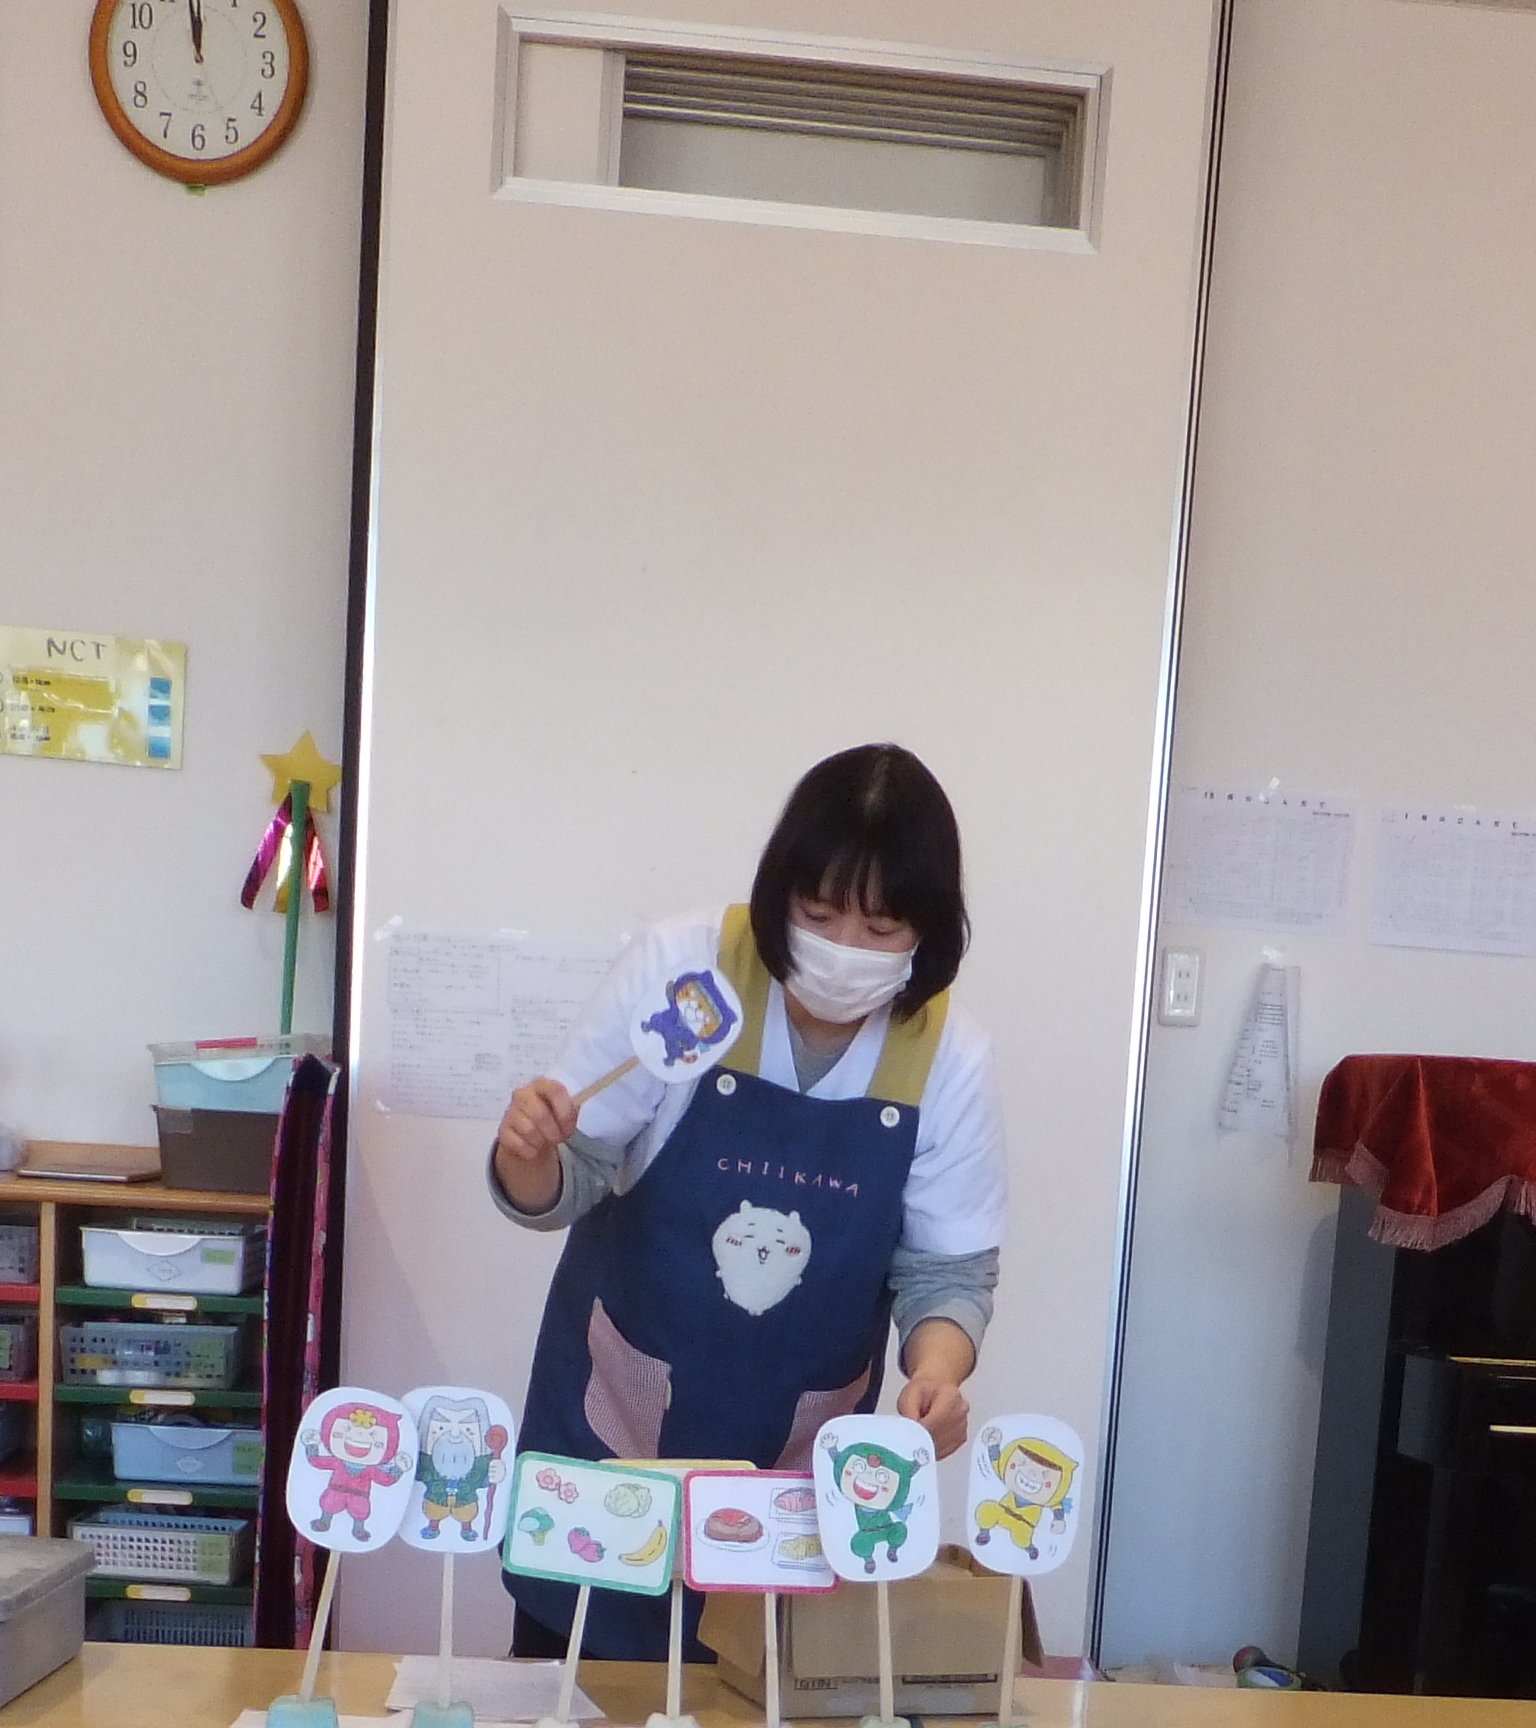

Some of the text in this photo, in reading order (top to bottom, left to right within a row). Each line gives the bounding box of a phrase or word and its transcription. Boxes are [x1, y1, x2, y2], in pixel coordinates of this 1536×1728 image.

[130, 2, 153, 29] 10
[253, 12, 267, 39] 2
[123, 40, 137, 67] 9
[261, 51, 275, 79] 3
[133, 81, 148, 108] 8
[250, 90, 264, 116] 4
[159, 112, 172, 139] 7
[191, 124, 205, 150] 6
[225, 118, 239, 144] 5
[45, 637, 107, 662] NCT
[717, 1158, 859, 1198] CHIIKAWA
